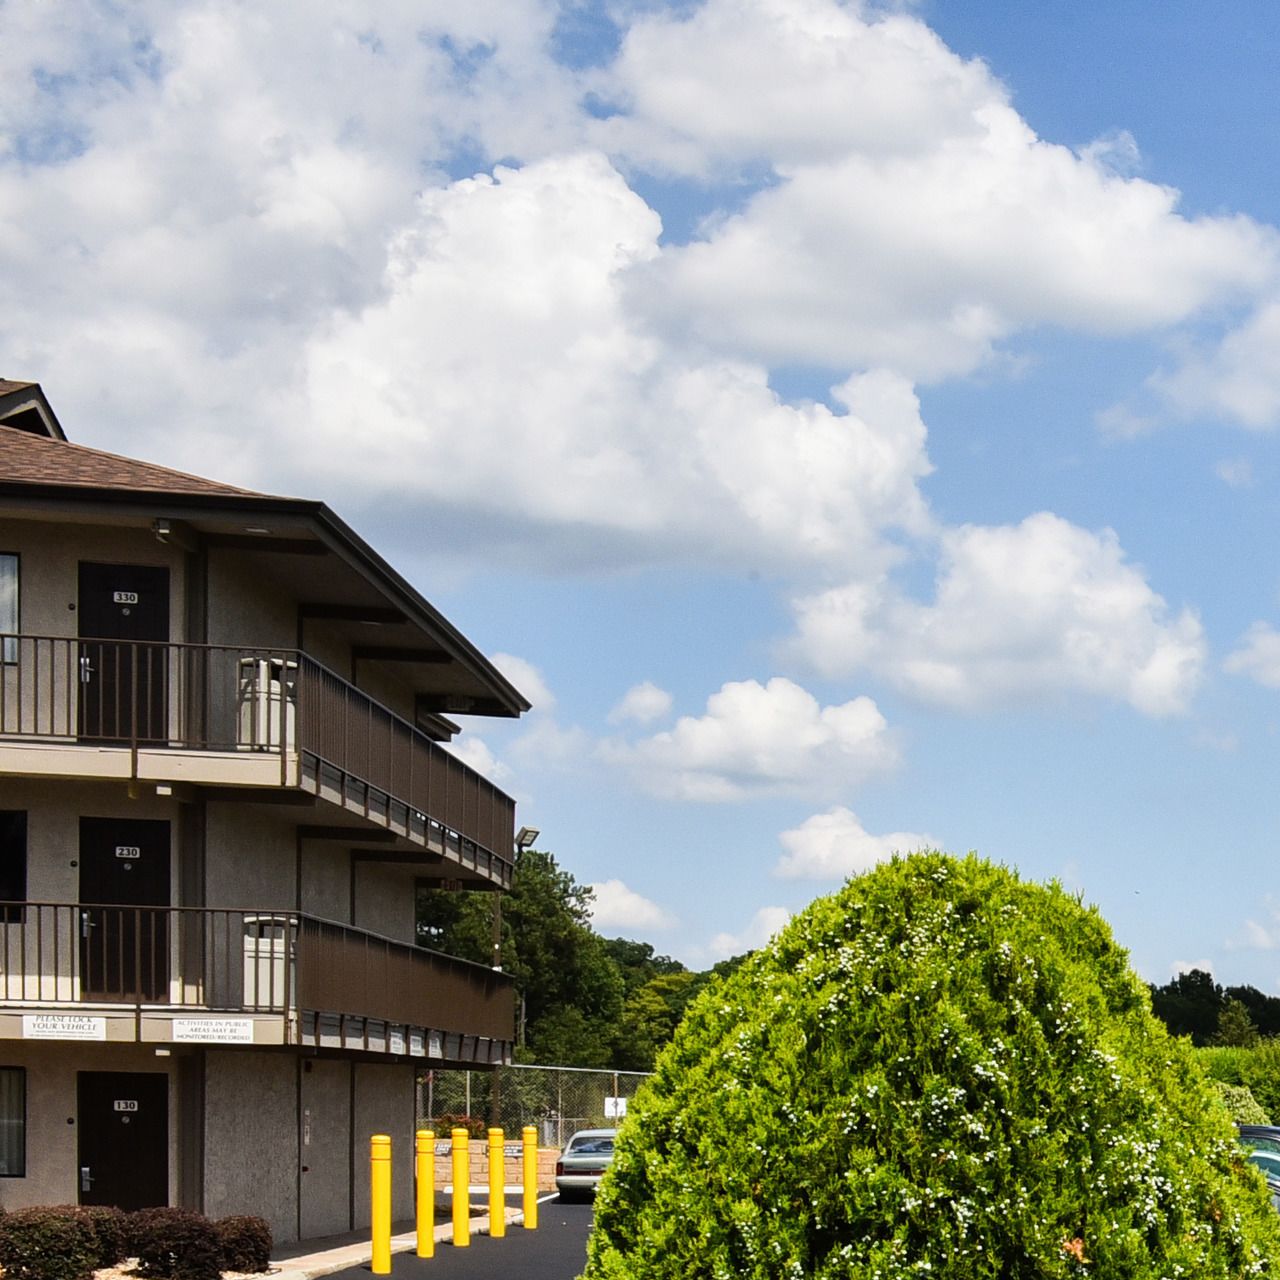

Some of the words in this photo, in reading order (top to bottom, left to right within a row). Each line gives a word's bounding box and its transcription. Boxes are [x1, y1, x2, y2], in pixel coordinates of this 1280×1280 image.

[118, 847, 138, 857] 230
[32, 1022, 58, 1030] YOUR
[117, 1101, 136, 1110] 130
